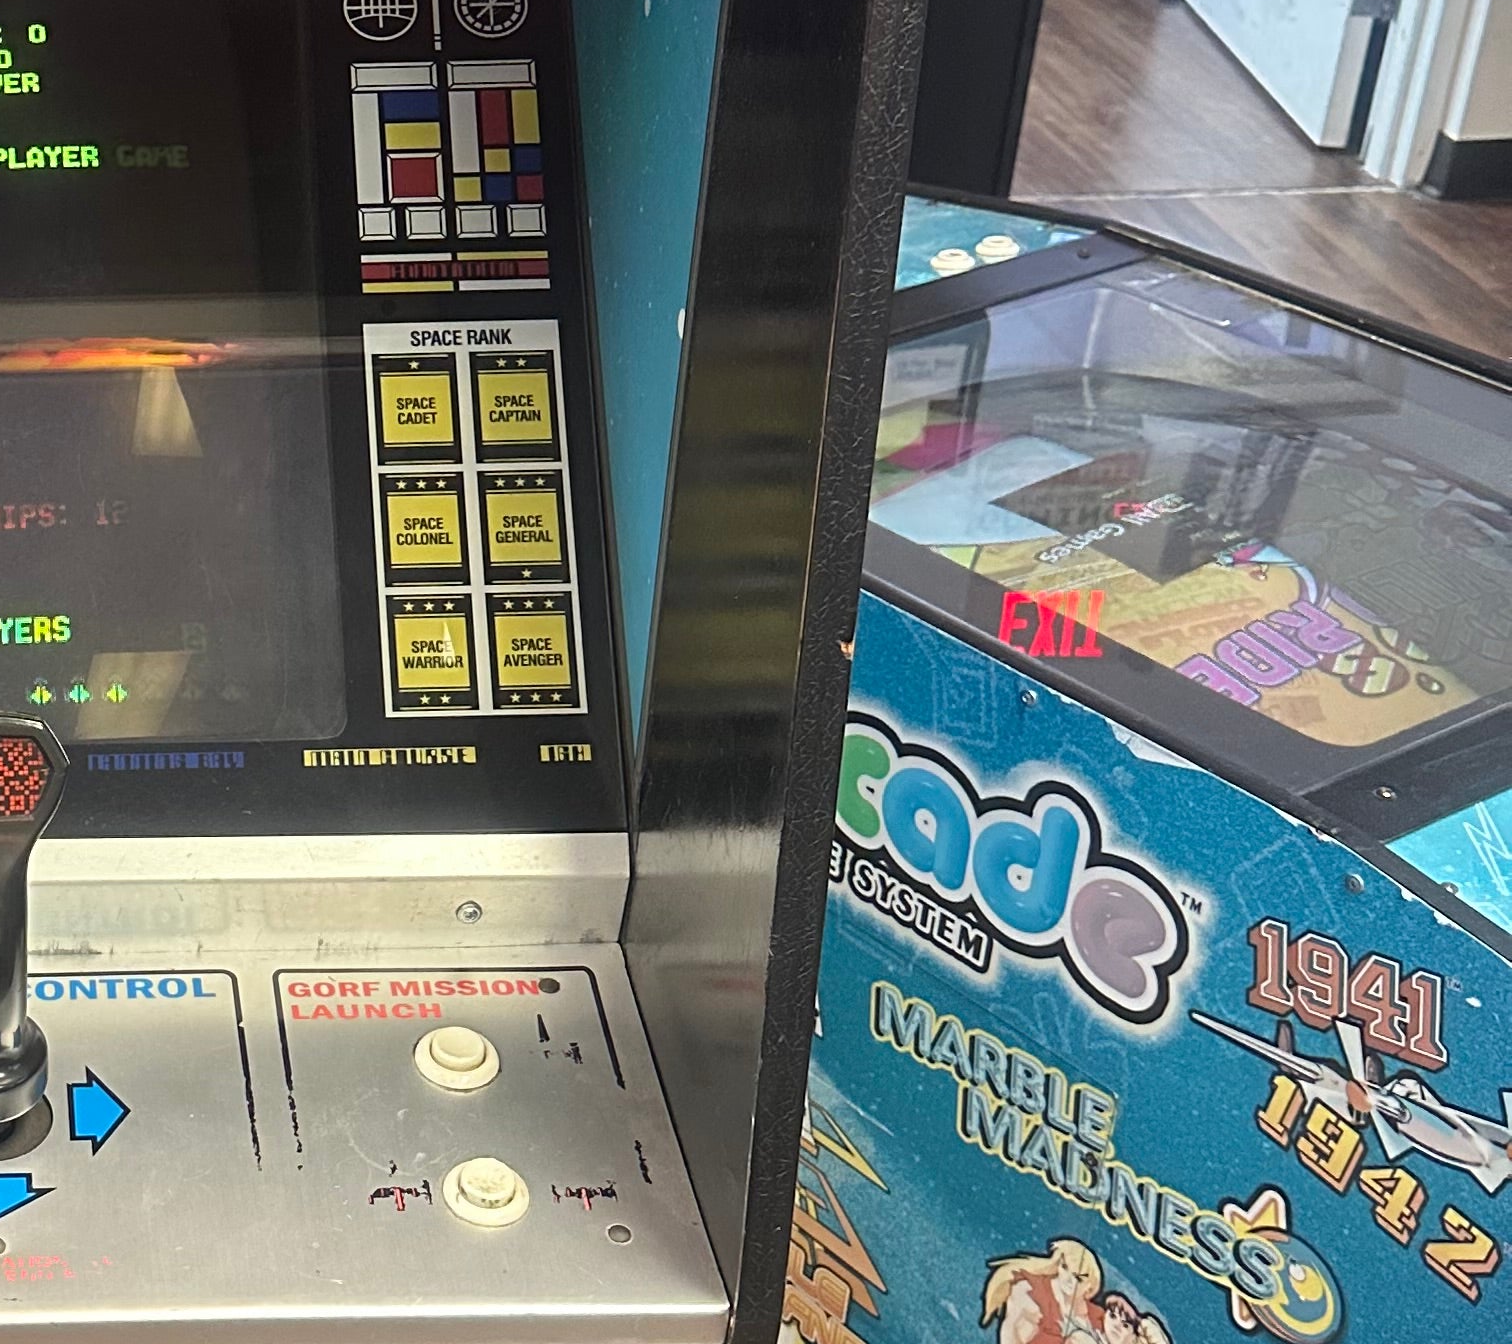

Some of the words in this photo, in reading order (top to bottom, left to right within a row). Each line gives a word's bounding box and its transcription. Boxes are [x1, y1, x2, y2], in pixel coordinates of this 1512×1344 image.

[27, 23, 48, 45] 0
[410, 329, 463, 347] SPACE
[466, 328, 513, 345] RANK
[396, 397, 436, 410] SPACE
[494, 394, 534, 408] SPACE
[397, 411, 438, 425] CADET
[489, 409, 542, 423] CAPTAIN
[403, 517, 444, 530] SPACE
[502, 515, 543, 528] SPACE
[396, 532, 453, 546] COLONEL
[495, 530, 553, 544] GENERAL
[411, 640, 451, 653] SPACE
[511, 637, 552, 652] SPACE
[402, 655, 464, 669] WARRIOR
[503, 653, 564, 668] AVENGER
[852, 858, 989, 969] SYSTEM
[25, 975, 216, 1001] ONTROL
[286, 980, 380, 999] GORF
[389, 978, 541, 998] MISSION
[1248, 919, 1449, 1071] 1941
[290, 1002, 444, 1020] LAUNCH
[872, 981, 1118, 1159] MARBLE
[958, 1077, 1287, 1307] MADNESS
[1257, 1076, 1499, 1304] 1942
